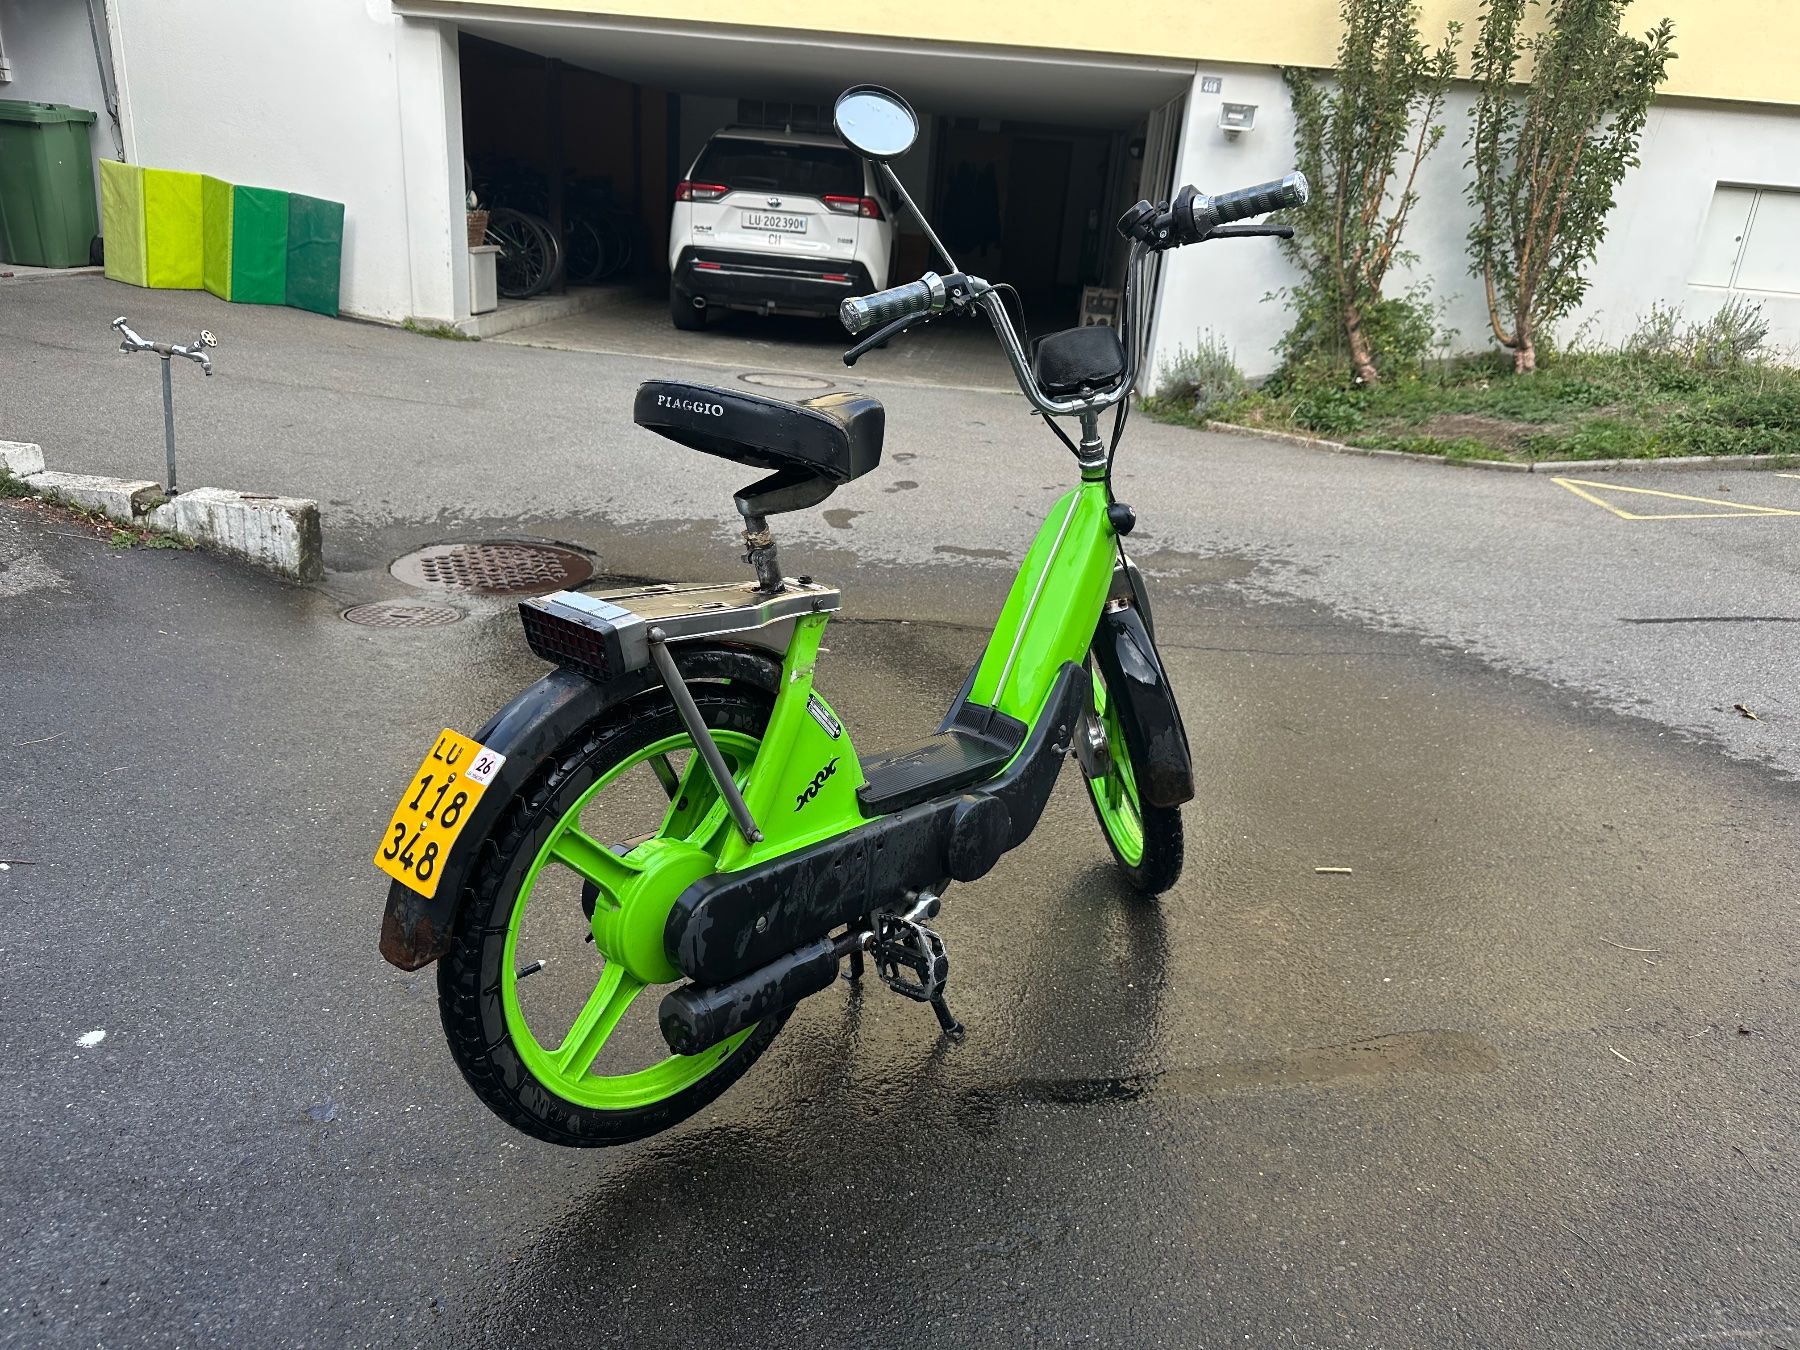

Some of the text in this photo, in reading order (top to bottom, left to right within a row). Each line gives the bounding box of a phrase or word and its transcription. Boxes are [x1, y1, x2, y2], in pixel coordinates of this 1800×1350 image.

[748, 214, 761, 226] LU
[657, 394, 724, 417] PIAGGIO
[433, 737, 464, 765] LU
[475, 757, 495, 775] 26
[409, 774, 468, 829] 118
[383, 822, 439, 881] 348
